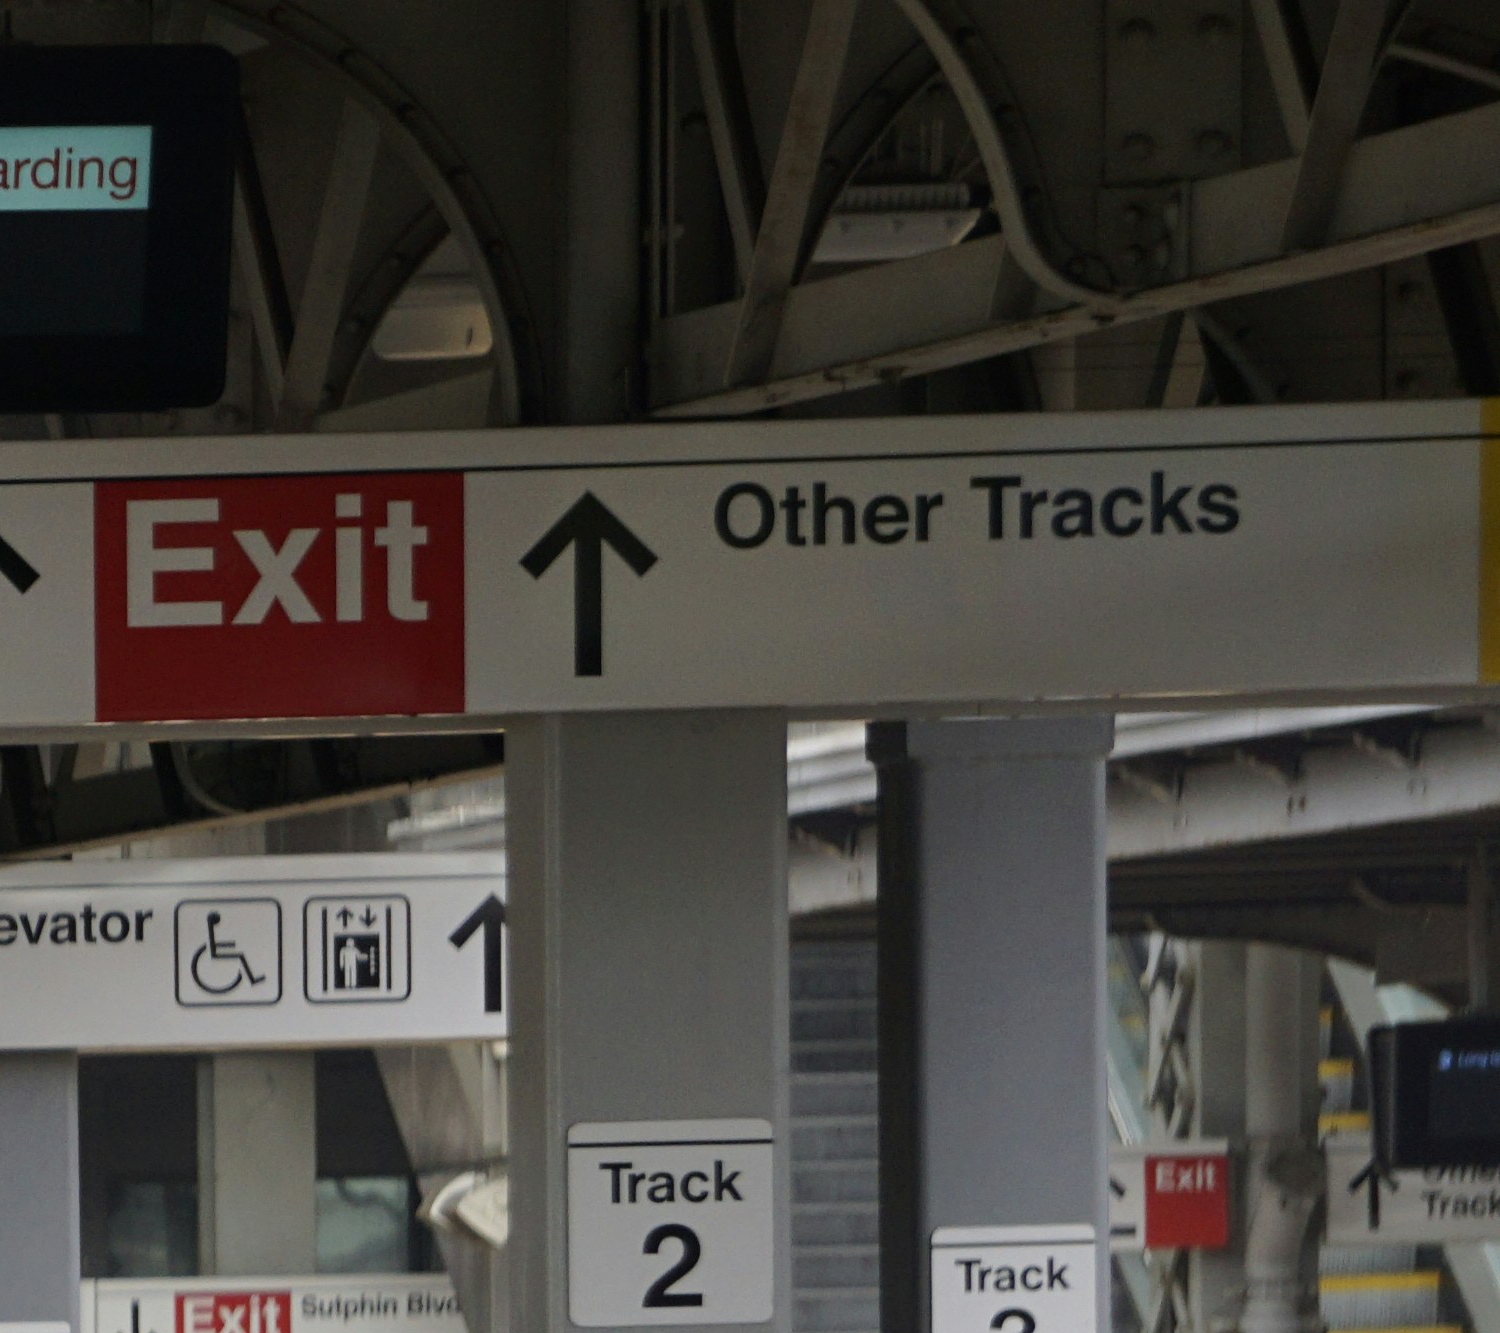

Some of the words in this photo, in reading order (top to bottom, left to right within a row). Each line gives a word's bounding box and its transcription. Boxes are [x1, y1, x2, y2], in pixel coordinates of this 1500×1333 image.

[714, 481, 944, 550] Other
[969, 470, 1240, 540] Tracks
[126, 493, 428, 628] Exit
[599, 1161, 743, 1204] Track
[1155, 1161, 1215, 1192] Exit
[642, 1223, 704, 1308] 2
[955, 1257, 1069, 1293] Track
[302, 1294, 399, 1321] Sutphin
